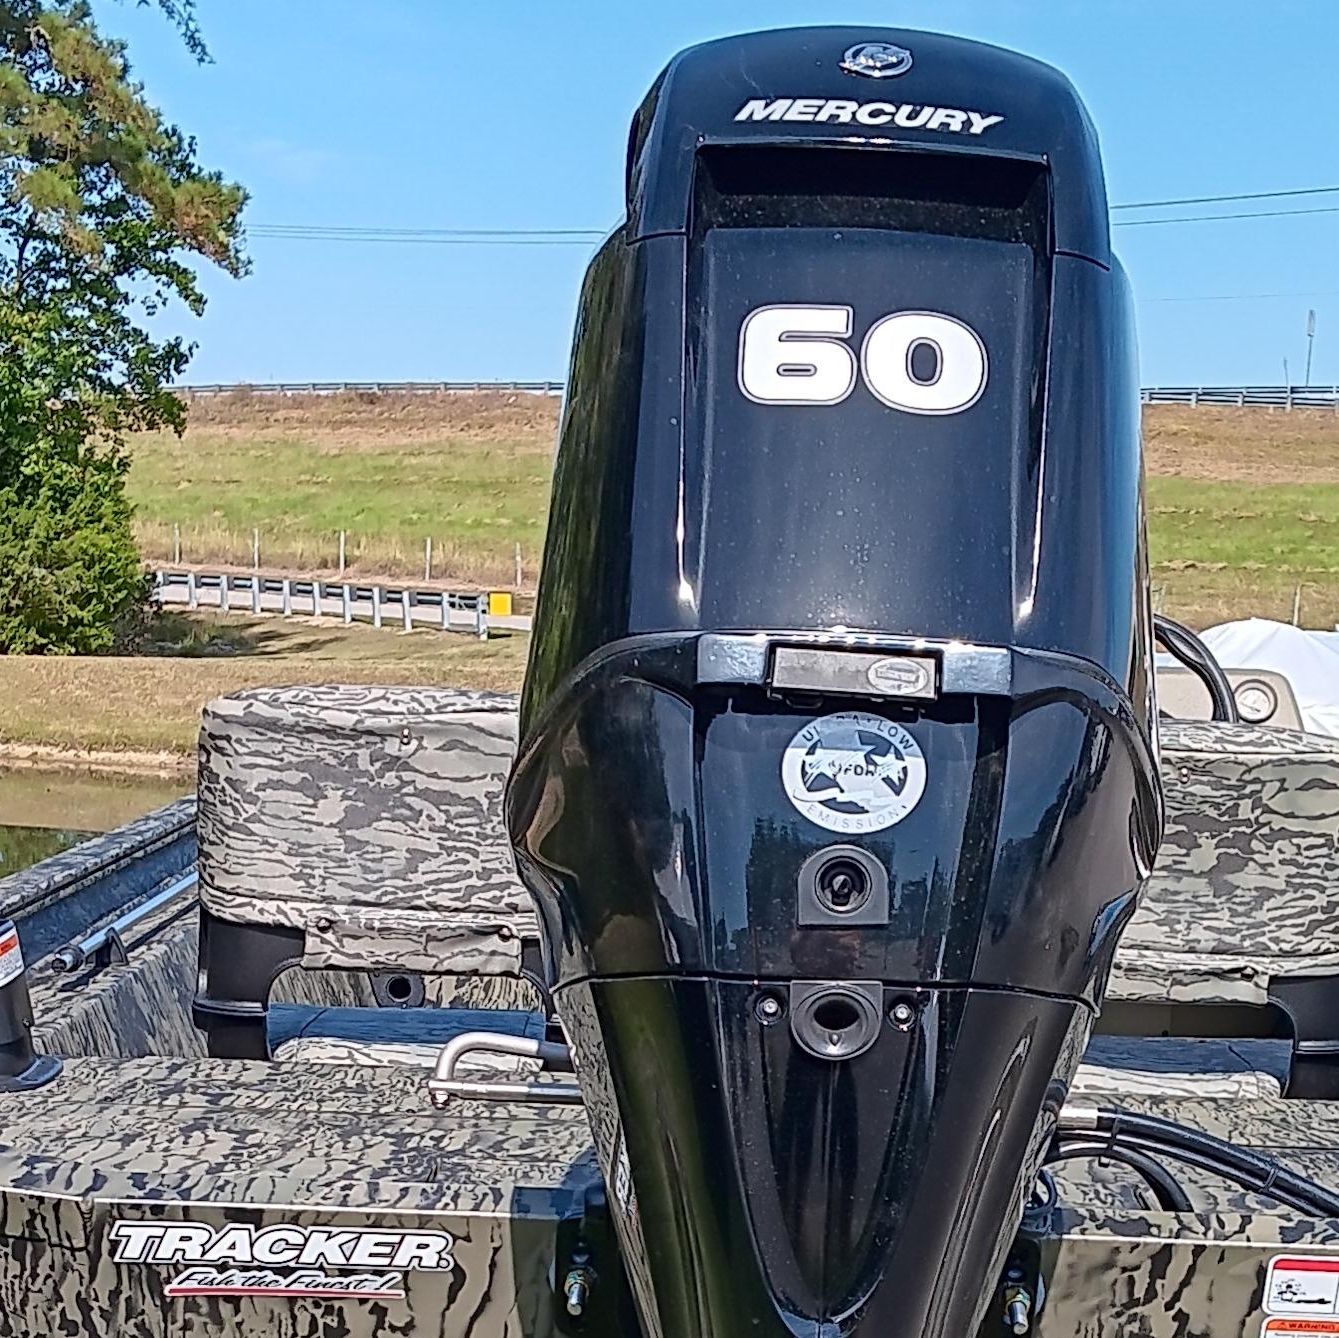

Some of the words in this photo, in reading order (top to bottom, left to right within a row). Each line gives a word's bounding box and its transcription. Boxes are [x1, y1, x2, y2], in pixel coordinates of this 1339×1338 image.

[734, 98, 1005, 135] MERCURY
[737, 303, 989, 415] 60
[877, 719, 914, 750] LOW
[114, 1224, 451, 1268] TRACKER
